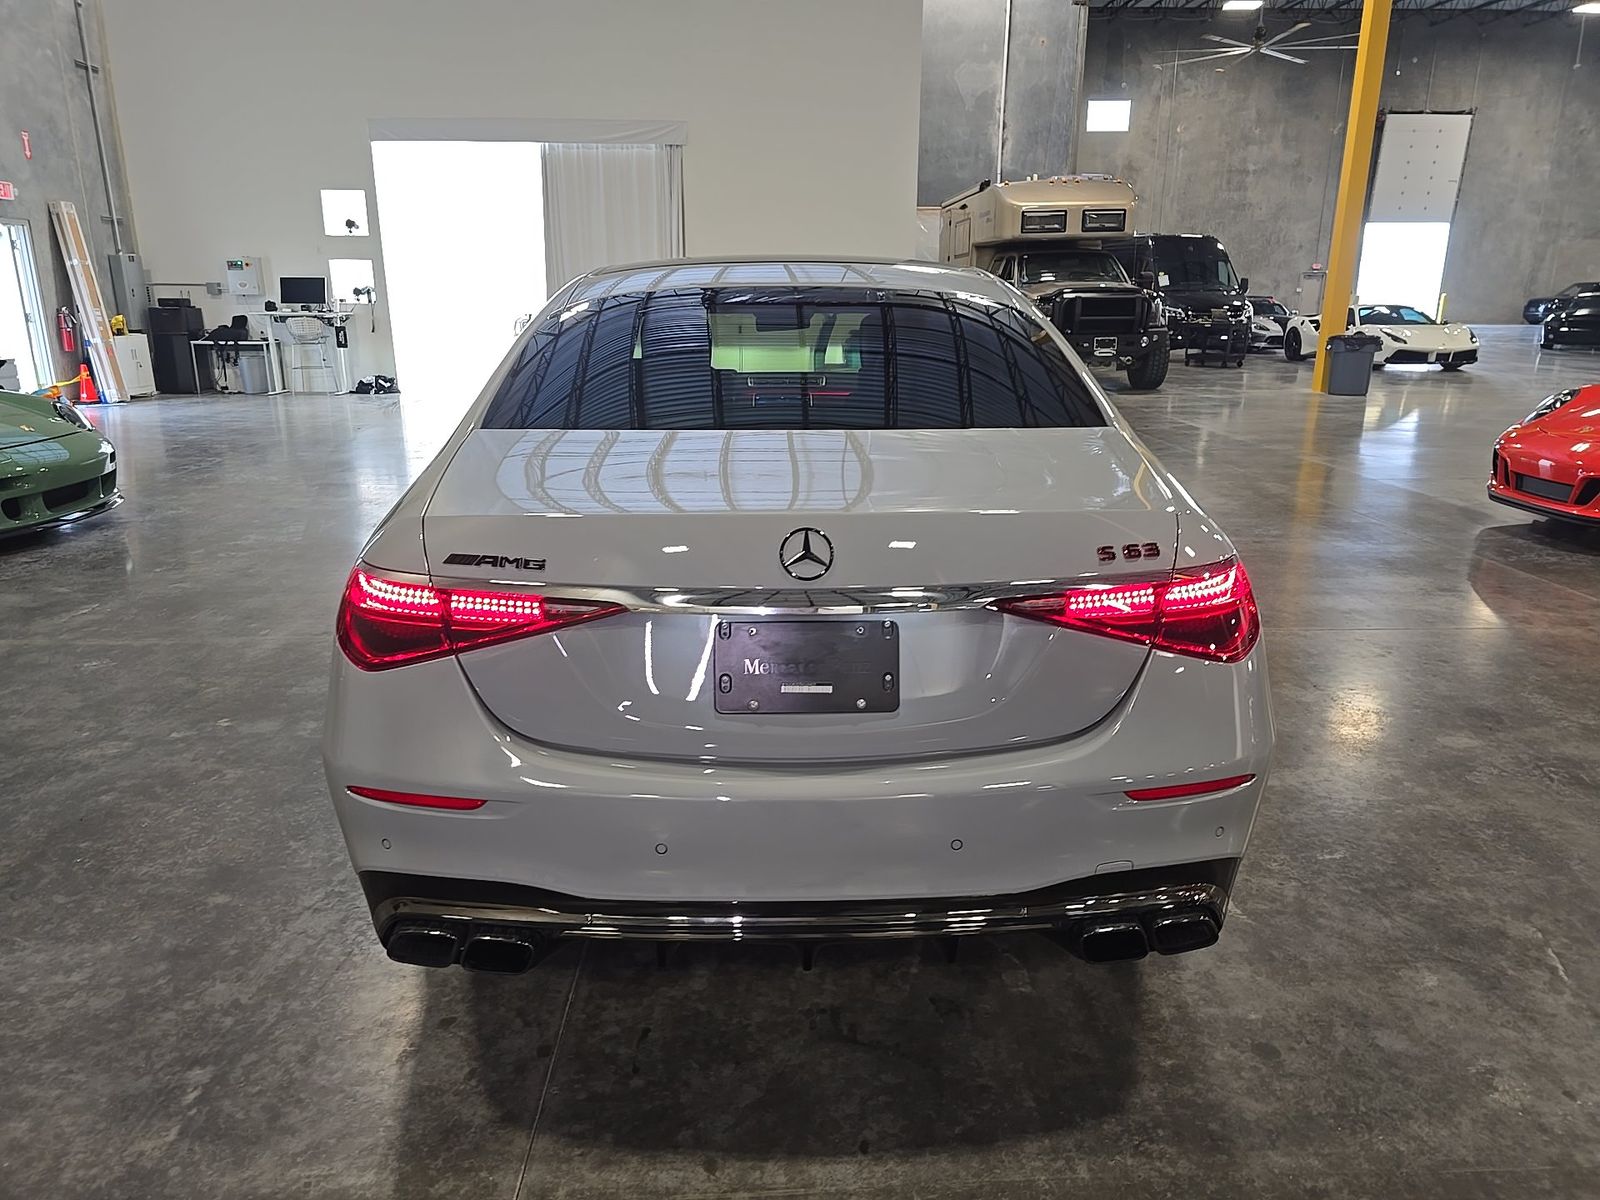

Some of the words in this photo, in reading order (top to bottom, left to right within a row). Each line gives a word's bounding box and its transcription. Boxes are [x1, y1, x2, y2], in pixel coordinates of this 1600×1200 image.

[1096, 546, 1117, 562] S
[1122, 542, 1161, 561] 63
[475, 554, 547, 571] AMG
